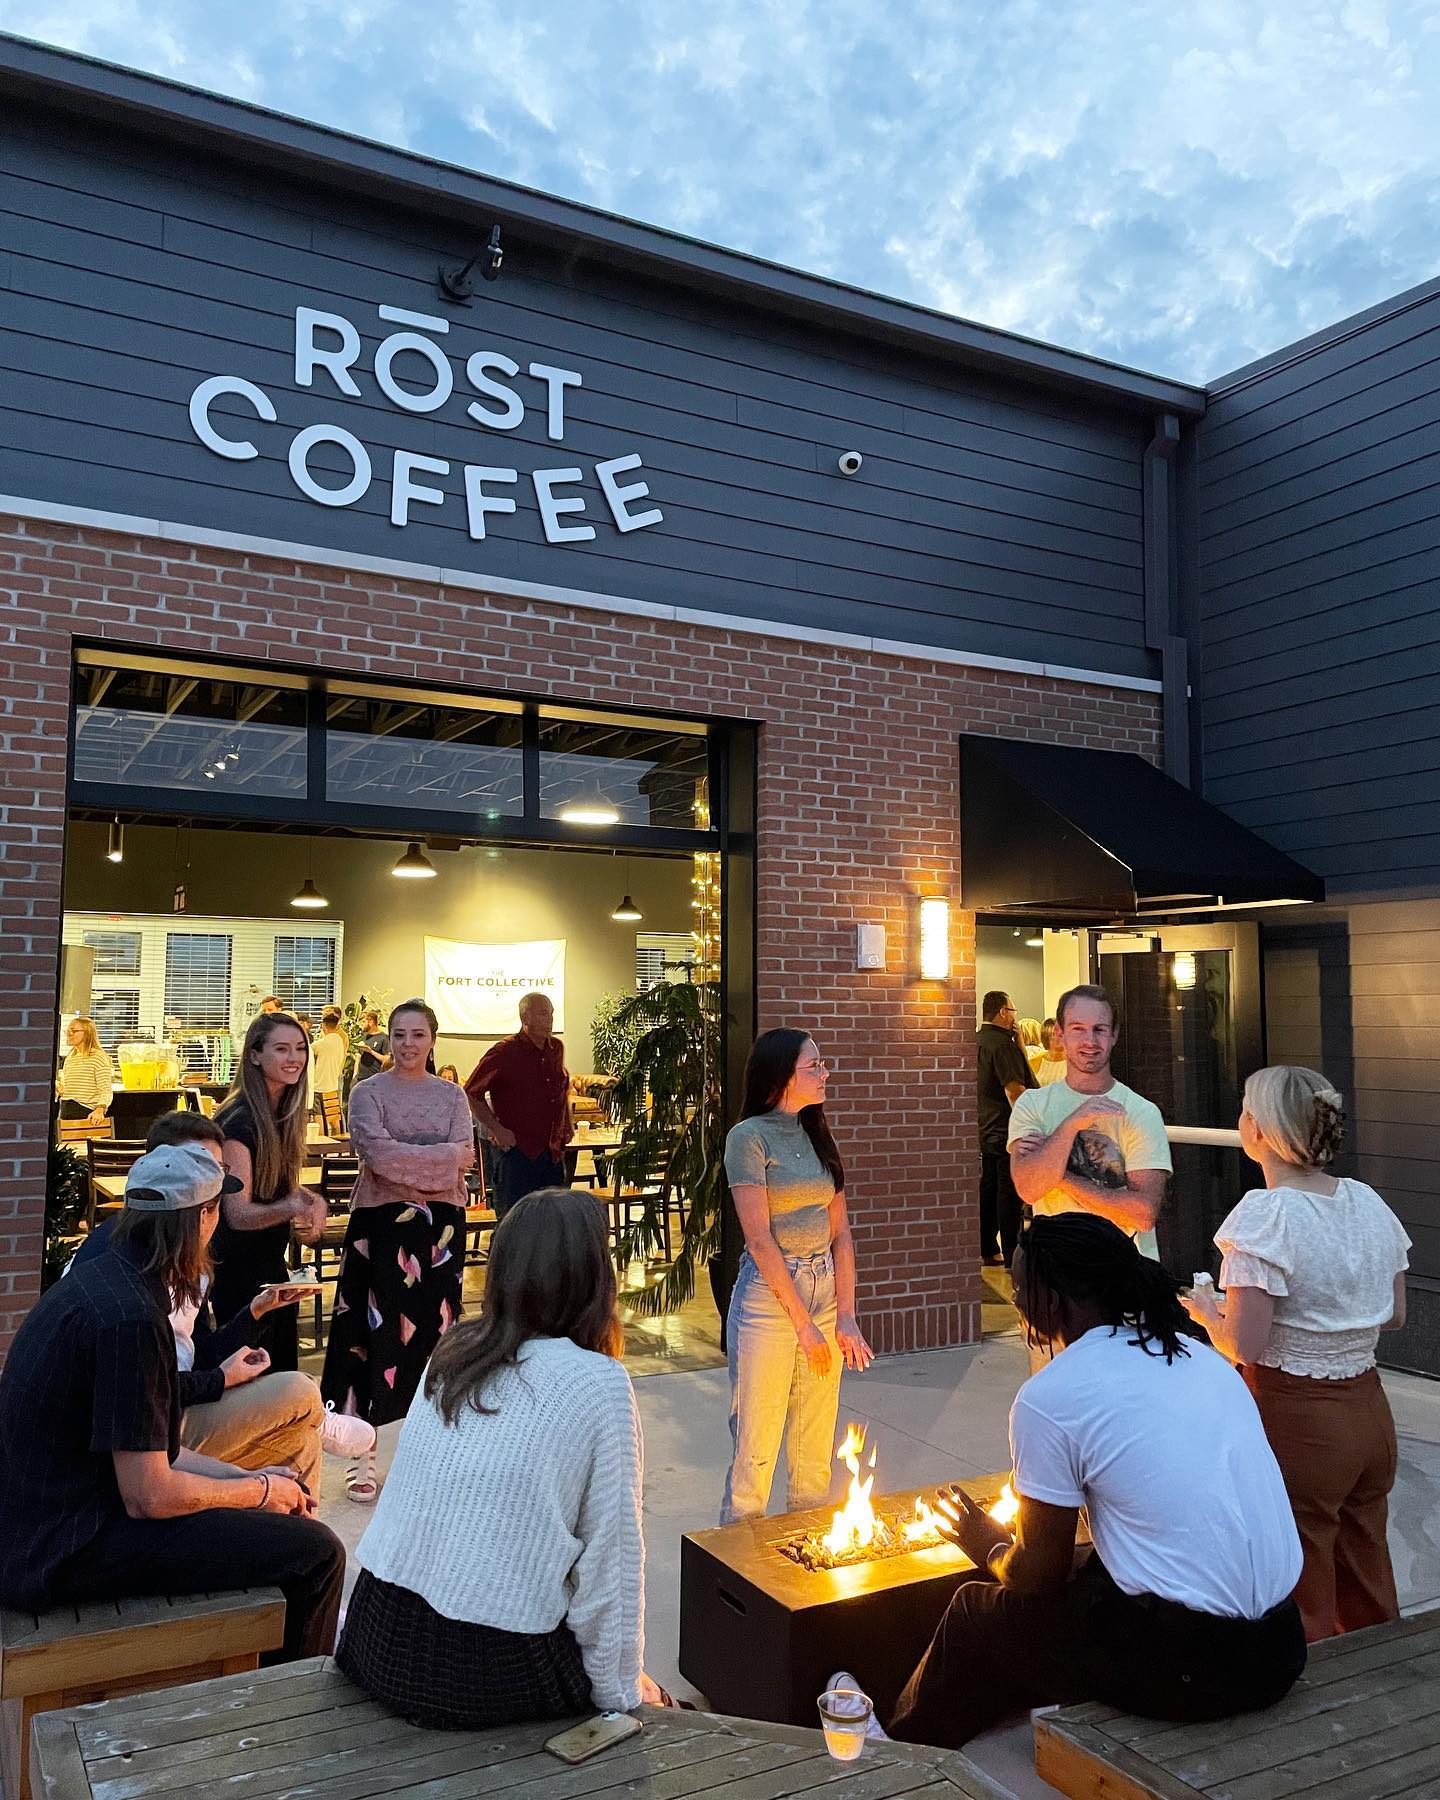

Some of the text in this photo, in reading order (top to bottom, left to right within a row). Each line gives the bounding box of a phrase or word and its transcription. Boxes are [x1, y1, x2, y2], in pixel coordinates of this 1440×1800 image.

[295, 304, 582, 441] RŌST
[189, 375, 664, 544] COFFEE
[438, 977, 554, 987] FORT COLLECTIVE
